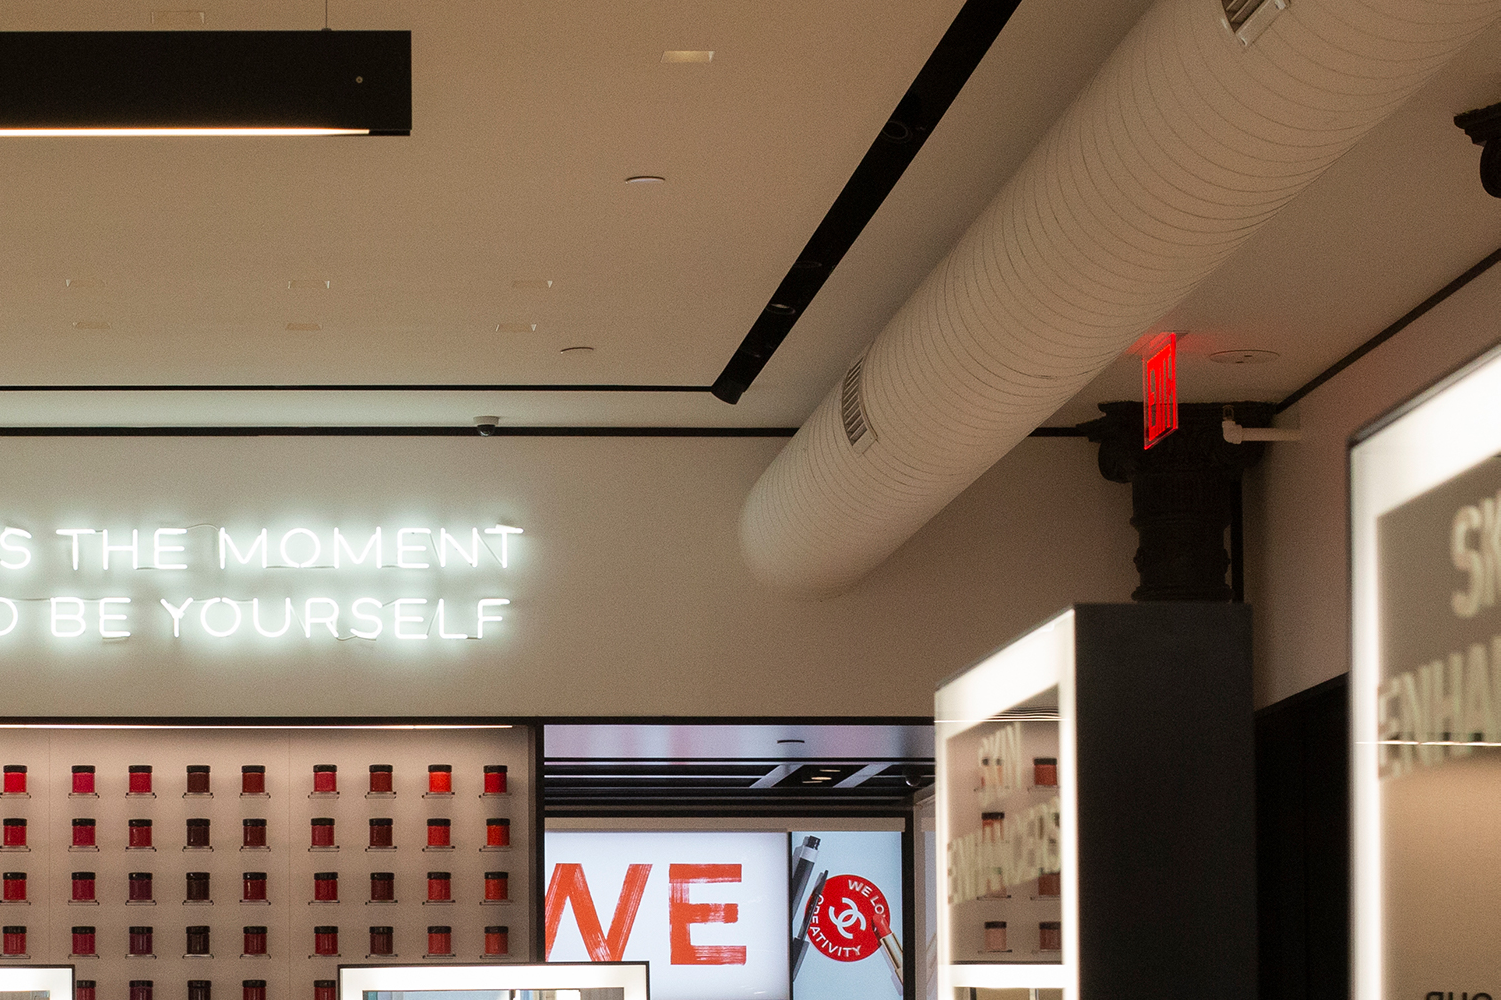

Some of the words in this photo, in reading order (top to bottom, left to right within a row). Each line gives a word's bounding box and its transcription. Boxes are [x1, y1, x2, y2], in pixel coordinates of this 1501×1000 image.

[55, 527, 188, 570] THE
[219, 523, 524, 570] MOMENT
[50, 596, 131, 638] BE
[160, 597, 510, 639] YOURSELF
[545, 863, 747, 966] WE
[847, 879, 874, 898] WE
[870, 895, 886, 918] LO
